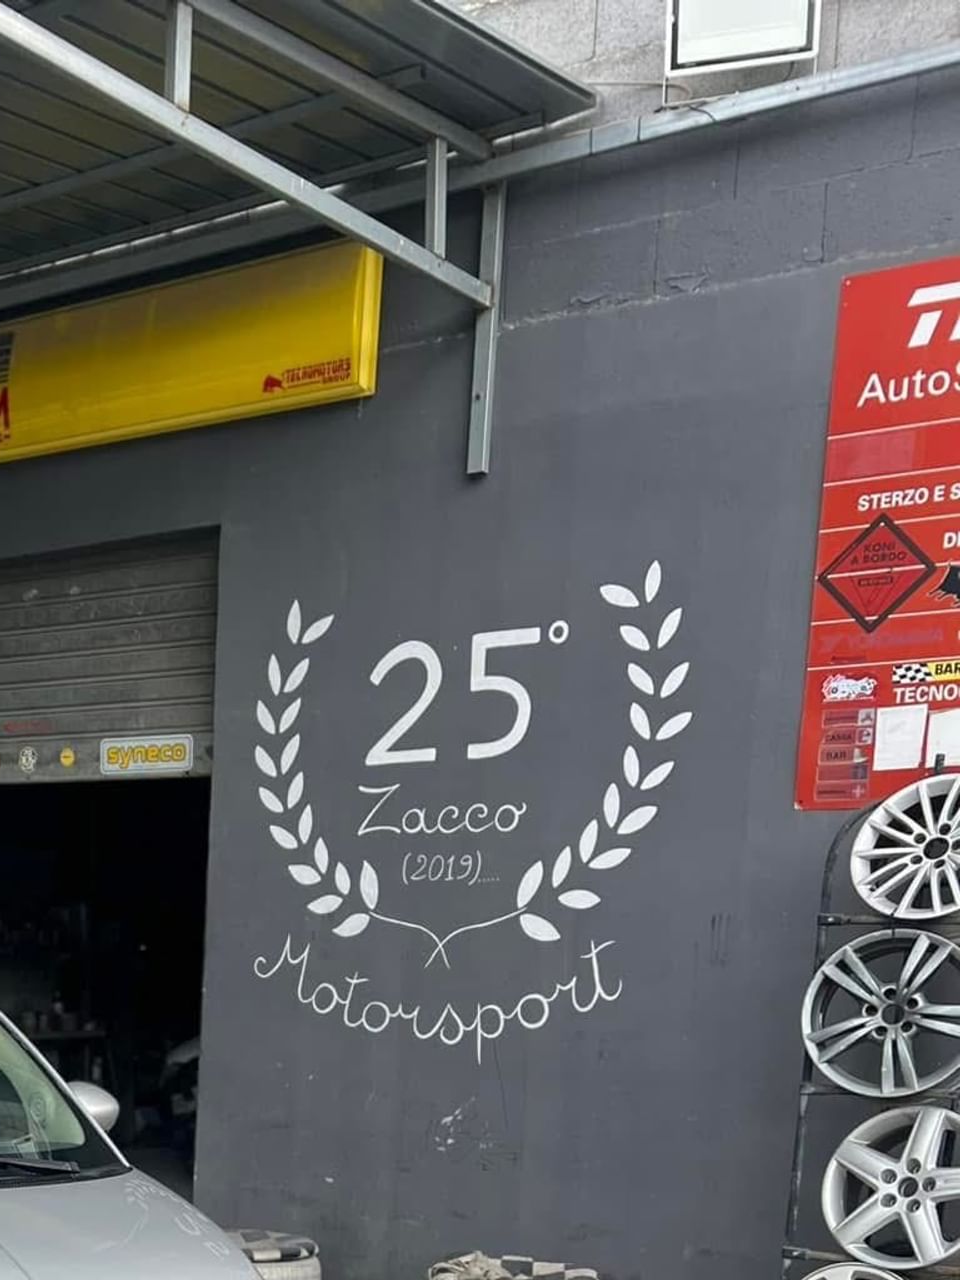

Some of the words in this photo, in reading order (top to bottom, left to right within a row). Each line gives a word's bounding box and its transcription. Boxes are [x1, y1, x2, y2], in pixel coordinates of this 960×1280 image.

[907, 281, 960, 348] T
[857, 487, 929, 511] STERZO
[933, 484, 946, 502] E
[893, 684, 960, 704] TECNO
[106, 742, 187, 769] syneco
[357, 783, 528, 836] Zacco
[254, 933, 623, 1065] Motorsport
